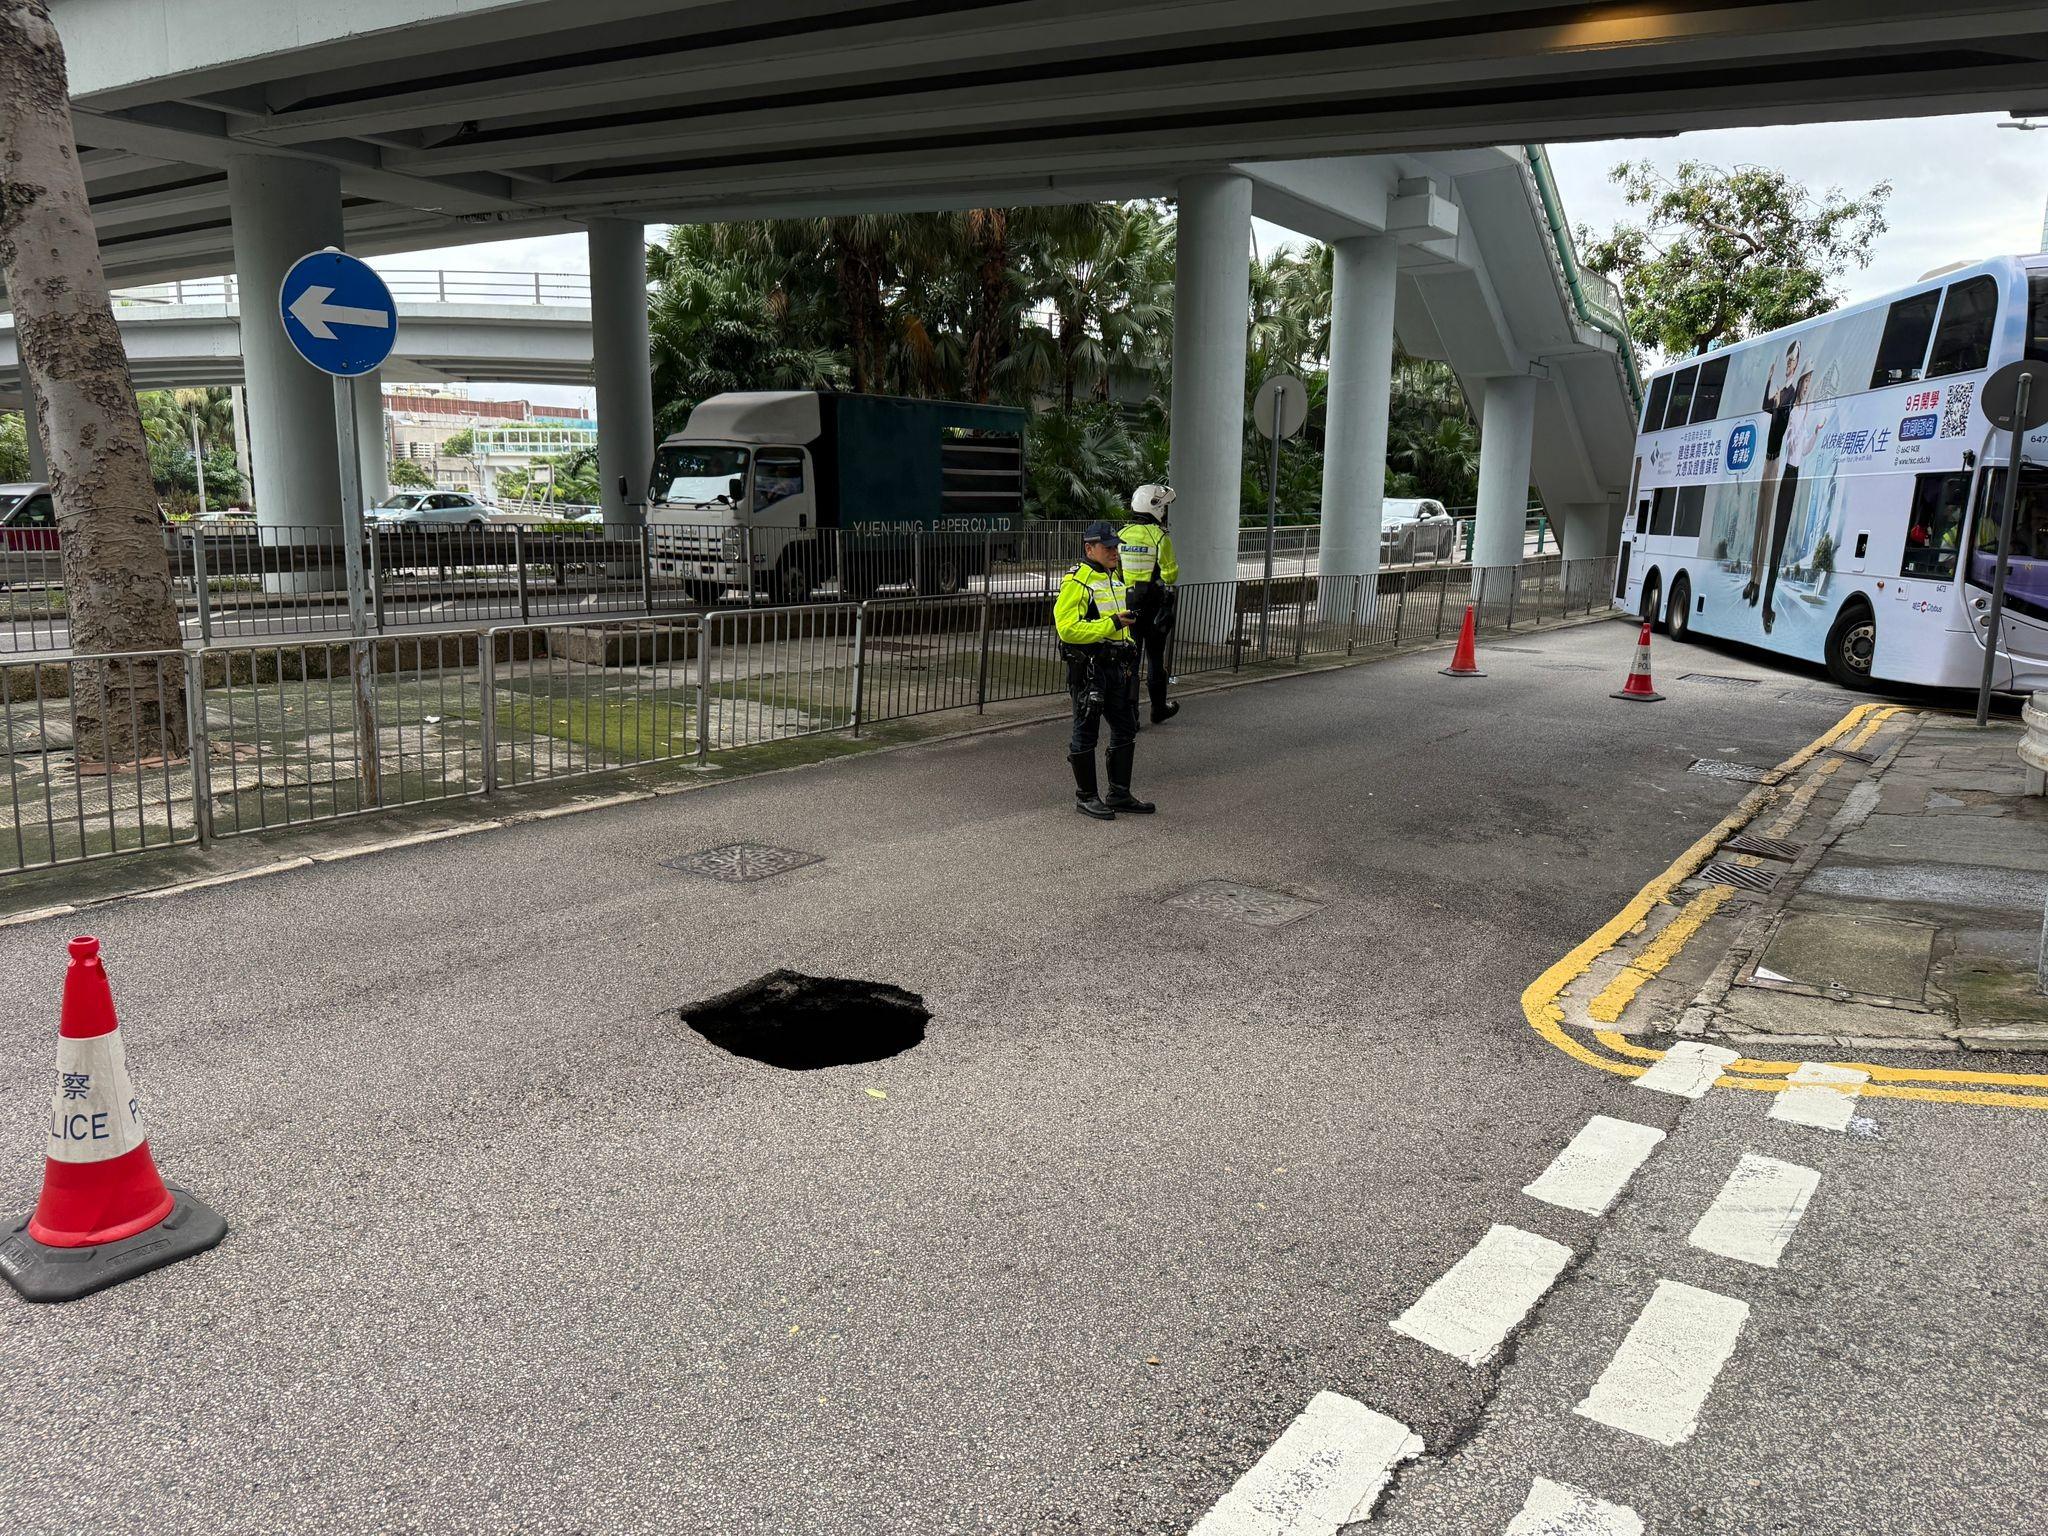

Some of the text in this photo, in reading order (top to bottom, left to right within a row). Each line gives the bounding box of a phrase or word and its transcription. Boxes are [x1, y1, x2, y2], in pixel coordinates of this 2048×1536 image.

[1906, 391, 1939, 411] 9月開學
[1821, 428, 1891, 454] 以技能開展人生
[2030, 434, 2048, 445] 647
[853, 521, 890, 537] YUEN
[893, 520, 923, 536] HING
[933, 518, 969, 533] PAPER
[51, 1111, 110, 1141] LICE
